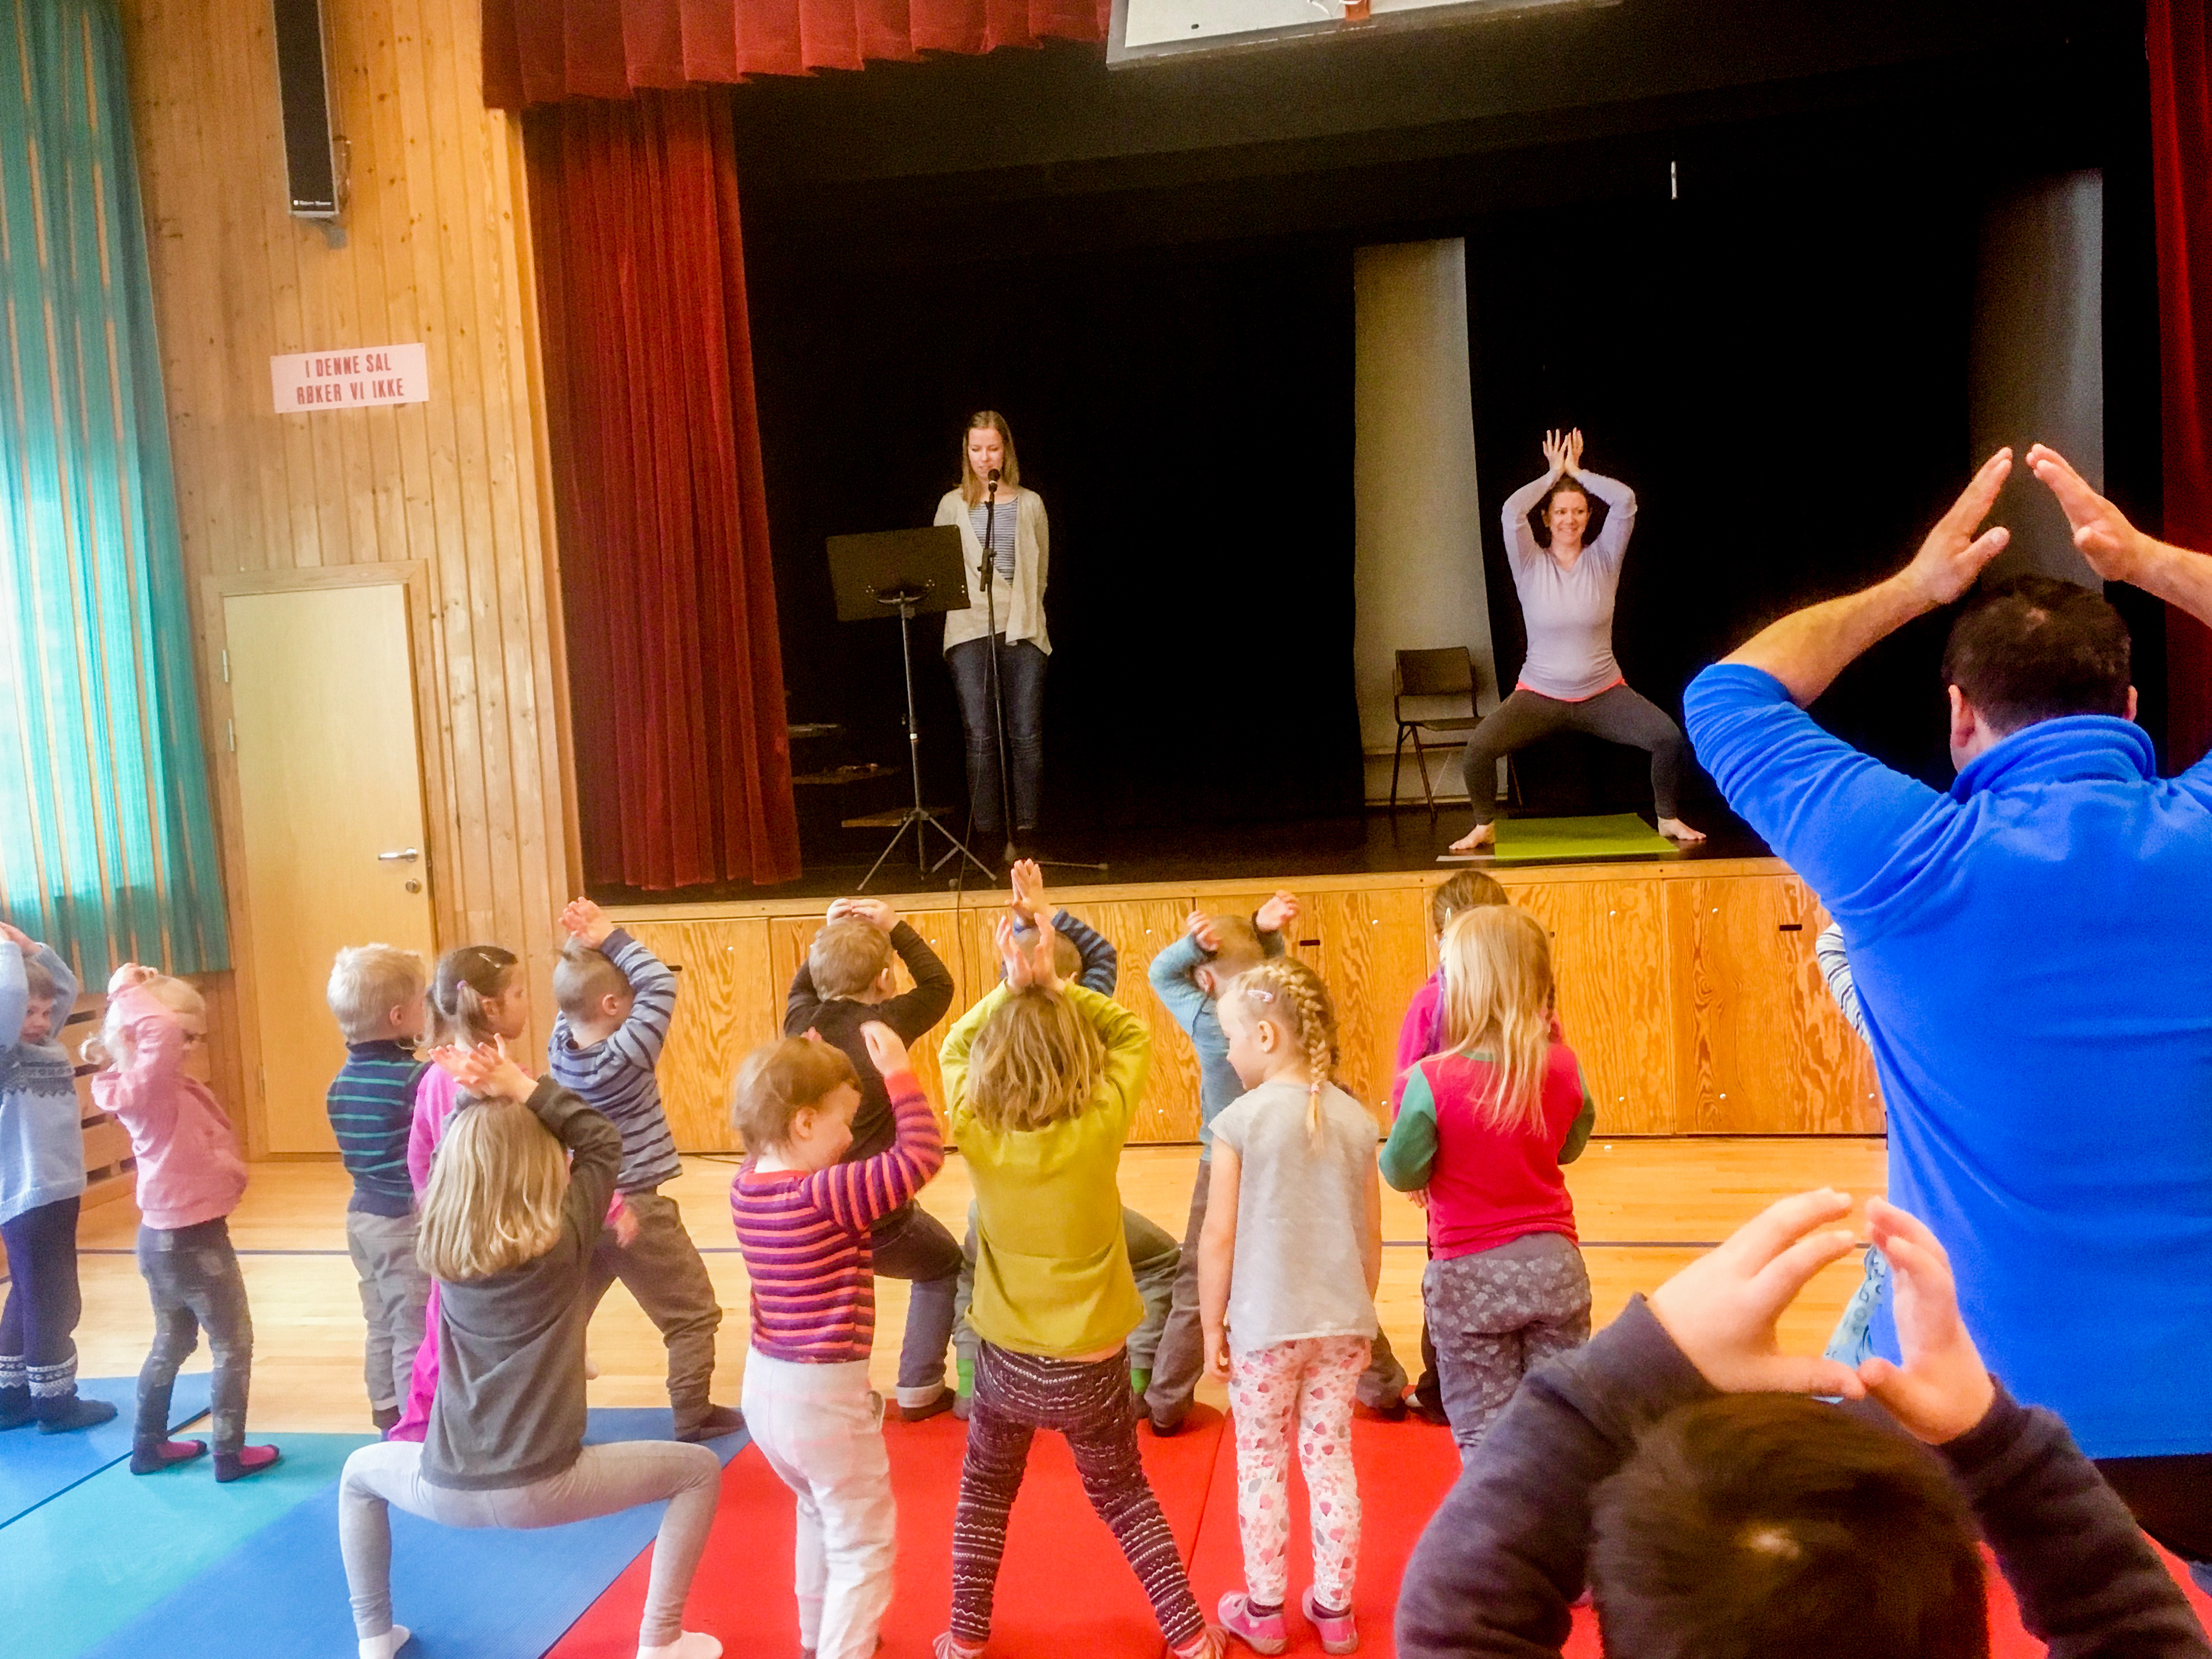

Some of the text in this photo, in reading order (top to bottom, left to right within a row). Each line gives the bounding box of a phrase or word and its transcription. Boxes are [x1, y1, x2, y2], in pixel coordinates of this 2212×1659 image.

[305, 352, 392, 378] I DENNE SAL
[296, 378, 405, 405] RØKER VI IKKE
